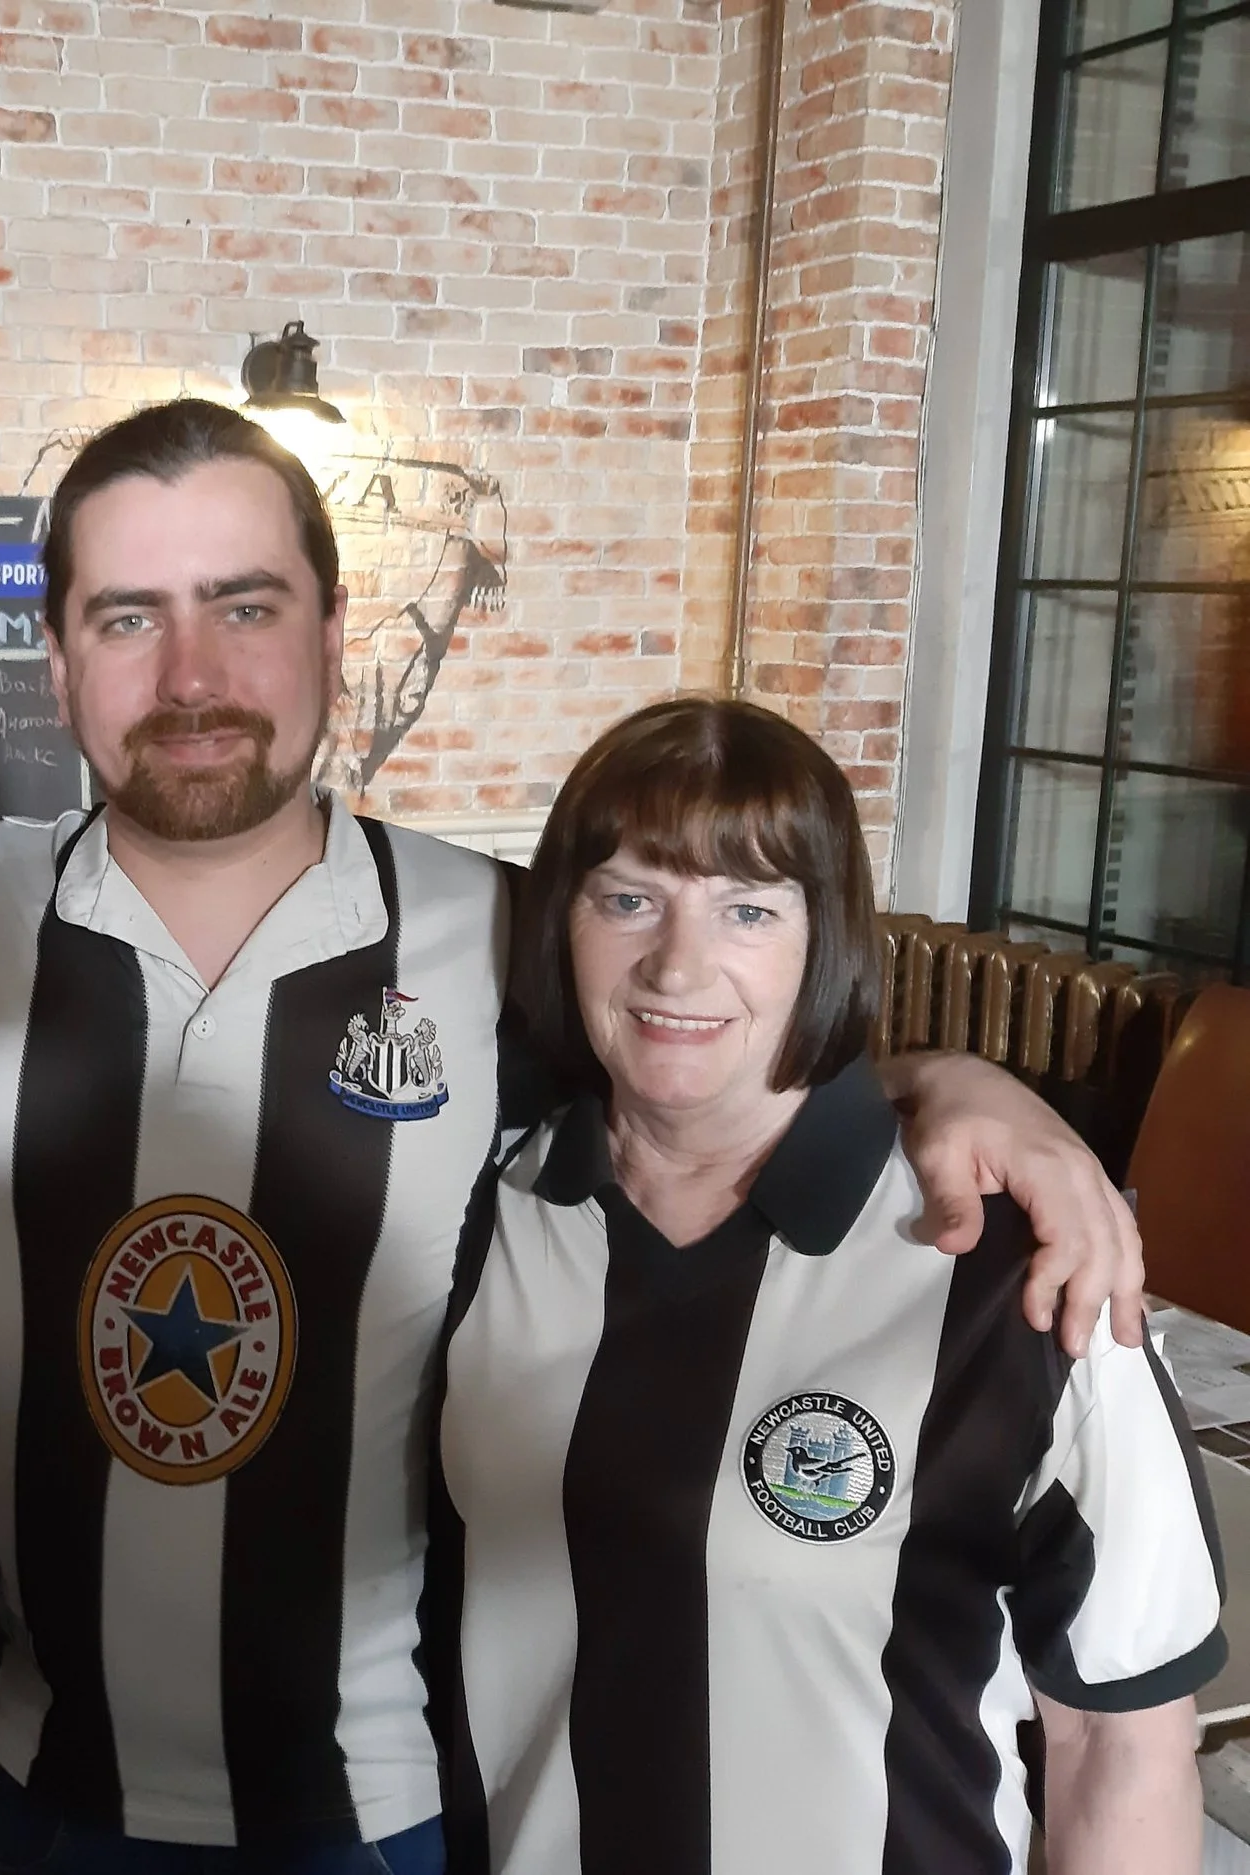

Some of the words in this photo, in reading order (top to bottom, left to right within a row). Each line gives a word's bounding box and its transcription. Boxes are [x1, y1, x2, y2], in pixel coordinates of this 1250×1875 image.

[106, 1221, 272, 1323] NEWCASTLE
[100, 1347, 209, 1460] BROWN
[219, 1368, 268, 1437] ALE
[750, 1396, 846, 1446] NEWCASTLE
[852, 1410, 890, 1472] UNITED
[751, 1479, 829, 1537] FOOTBALL
[834, 1505, 876, 1536] CLUB
